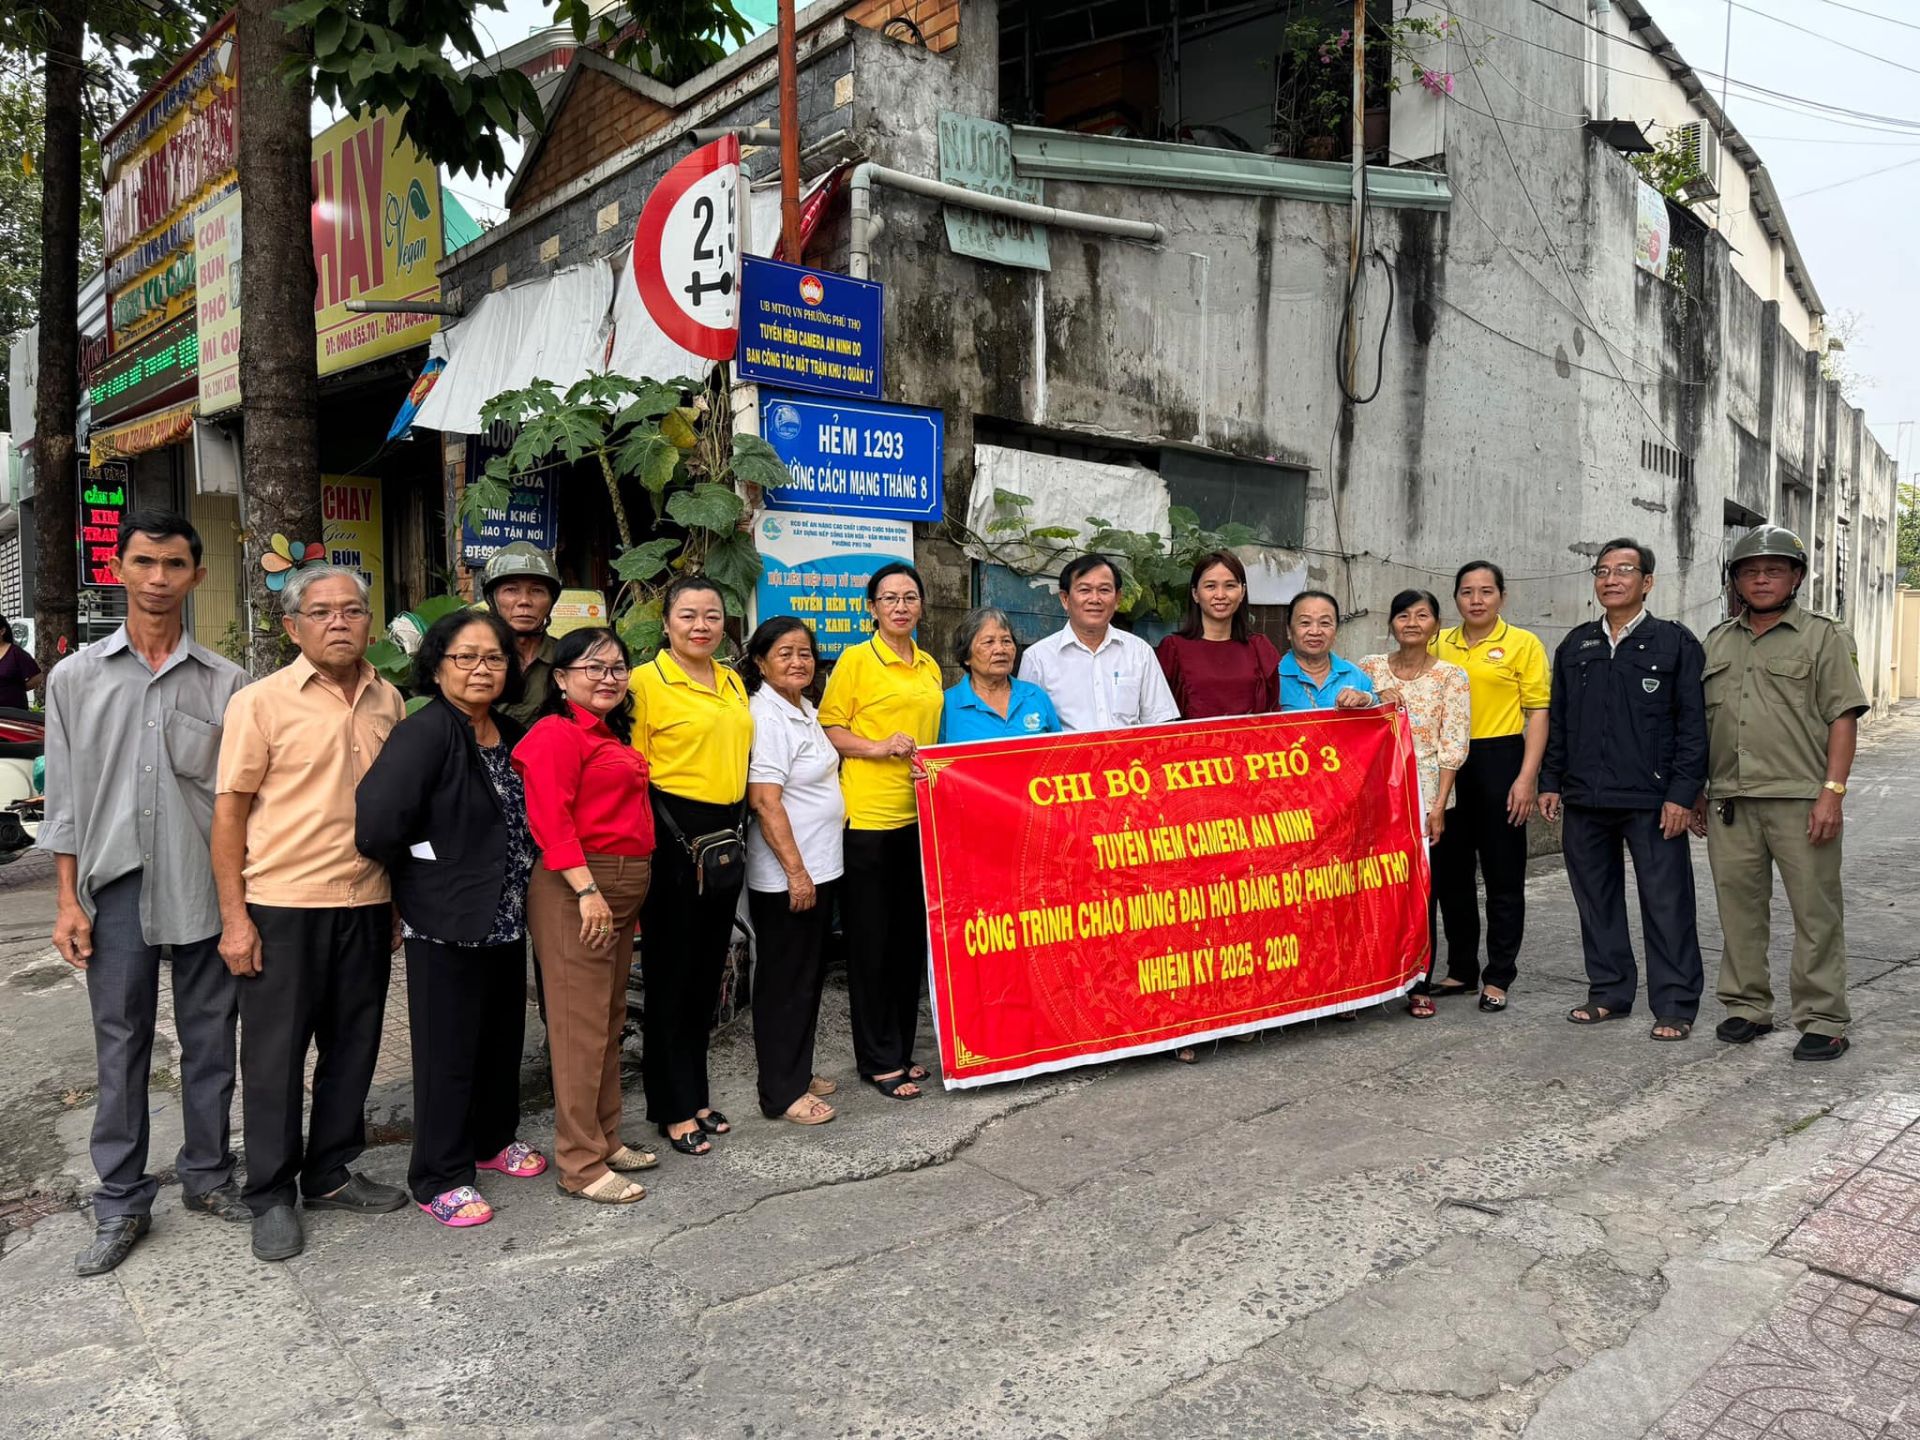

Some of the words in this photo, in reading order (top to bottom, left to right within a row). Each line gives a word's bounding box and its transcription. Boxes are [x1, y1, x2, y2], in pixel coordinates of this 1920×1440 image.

[312, 117, 385, 312] HAY
[760, 300, 770, 312] UB
[771, 302, 792, 318] MTTQ
[793, 307, 803, 318] VN
[803, 309, 832, 325] PHƯỜNG
[221, 326, 240, 356] QU
[760, 320, 782, 341] TUYẾN
[799, 331, 825, 351] CAMERA
[826, 336, 836, 353] AN
[836, 338, 852, 356] NINH
[746, 347, 760, 364] BAN
[761, 348, 780, 368] CÔNG
[781, 350, 795, 371] TÁC
[828, 362, 842, 379] KHU
[842, 366, 847, 380] 3
[847, 362, 865, 382] QUẢN
[865, 365, 874, 384] LÝ
[818, 413, 857, 456] HẺM
[864, 429, 904, 460] 1293
[818, 461, 846, 494] CÁCH
[850, 469, 880, 501] MẠNG
[882, 468, 916, 499] THÁNG
[920, 476, 928, 500] 8
[323, 485, 372, 521] CHAY
[83, 527, 118, 542] TRAN
[504, 525, 522, 540] TẬN
[527, 529, 543, 540] NƠI
[332, 548, 361, 566] BÚN
[790, 591, 823, 611] TUYẾN
[849, 595, 862, 615] TỰ
[825, 618, 851, 632] XANH
[1028, 772, 1096, 806] CHI
[1104, 758, 1151, 801] BỘ
[1162, 757, 1235, 791] KHU
[1244, 736, 1310, 781] PHỐ
[1320, 745, 1341, 772] 3
[1092, 816, 1149, 870] TUYẾN
[1149, 813, 1186, 862] HẺM
[1185, 817, 1250, 858] CAMERA
[1250, 813, 1276, 848] AN
[1273, 808, 1316, 845] NINH
[965, 908, 1017, 957] CÔNG
[1018, 898, 1074, 947] TRÌNH
[1077, 889, 1125, 939] CHÀO
[1127, 883, 1176, 931] MỪNG
[1179, 885, 1207, 932] ĐẠI
[1208, 872, 1237, 926] HỘI
[1238, 865, 1280, 913] ĐẢNG
[1282, 863, 1303, 914] BỘ
[1304, 855, 1355, 901] PHƯỜNG
[1357, 846, 1382, 891] PHÚ
[1380, 850, 1410, 891] THỌ
[1138, 946, 1191, 1000] NHIỆM
[1192, 938, 1214, 985] KỲ
[1220, 941, 1254, 980] 2025
[1265, 933, 1299, 972] 2030
